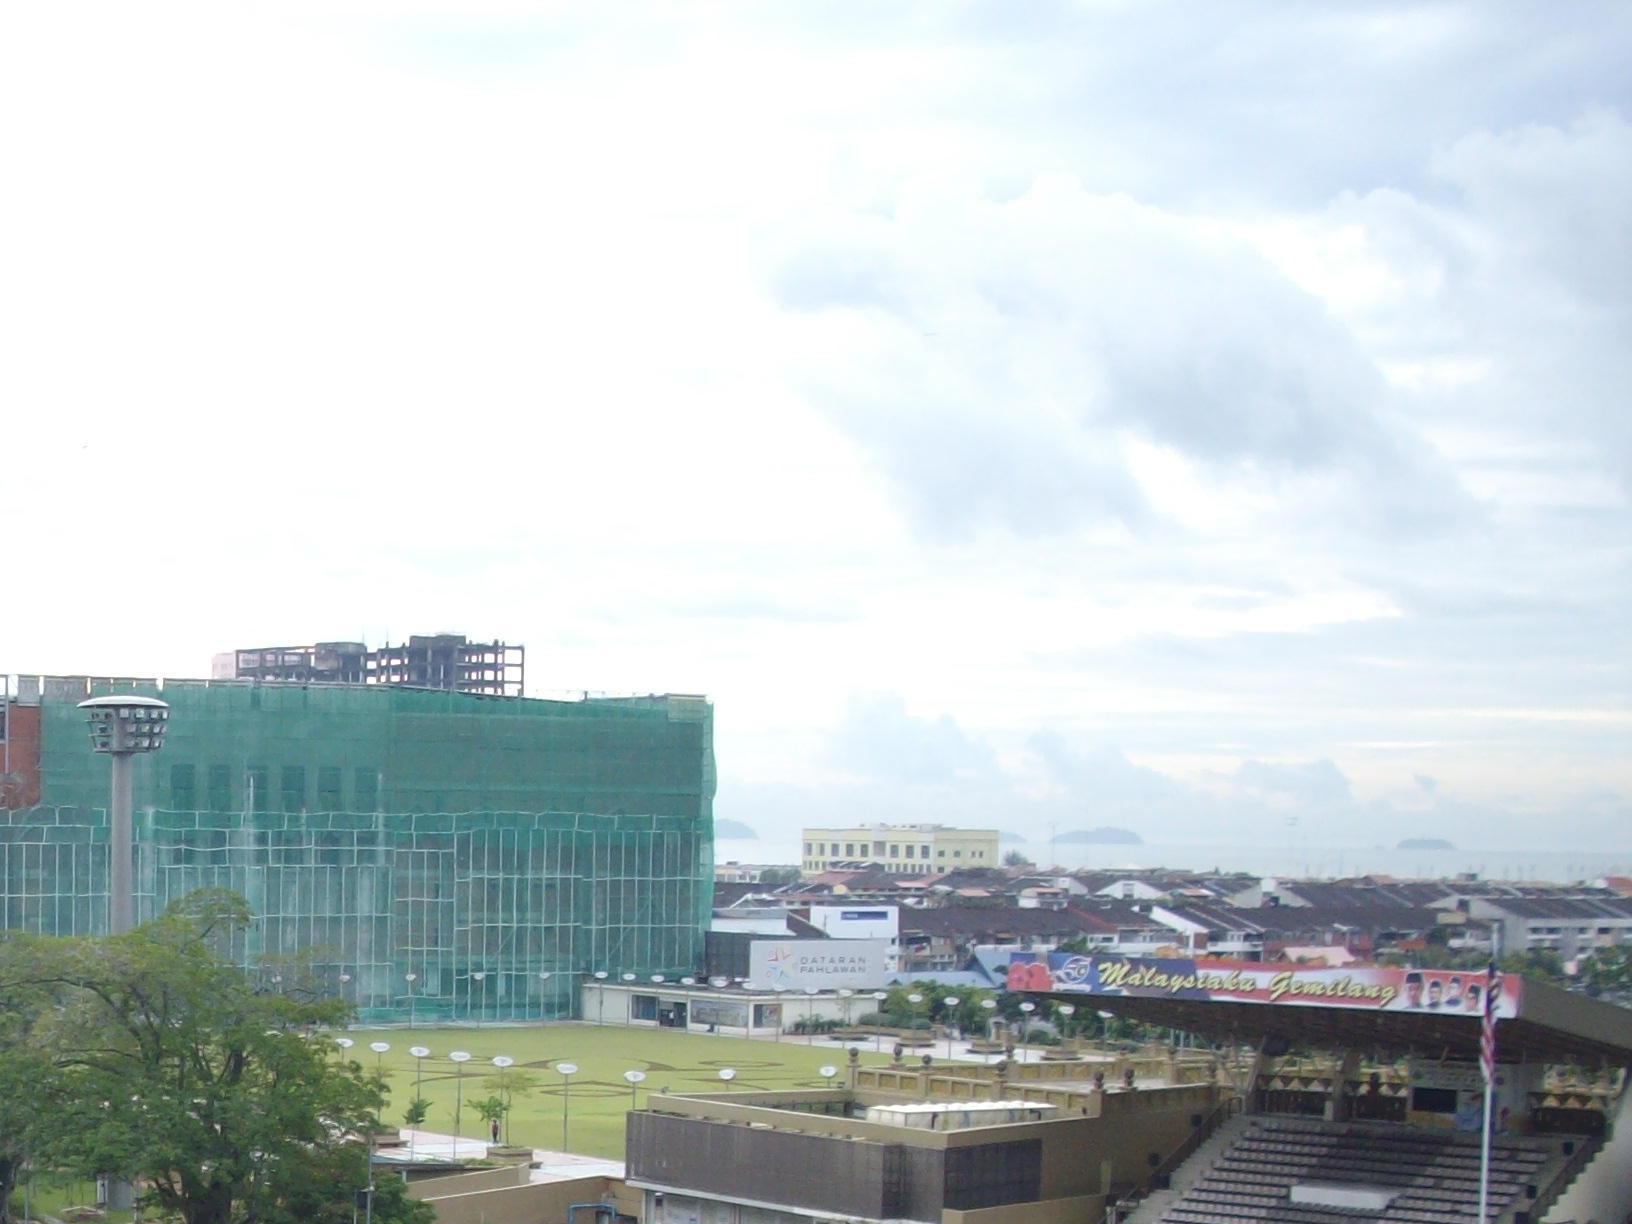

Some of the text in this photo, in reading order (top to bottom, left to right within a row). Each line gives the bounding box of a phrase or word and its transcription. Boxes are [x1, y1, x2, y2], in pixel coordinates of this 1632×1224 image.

[800, 956, 866, 965] DATARAN
[800, 966, 866, 974] PAHLAWAN
[1097, 961, 1398, 1009] Malaysiaku Gemilang
